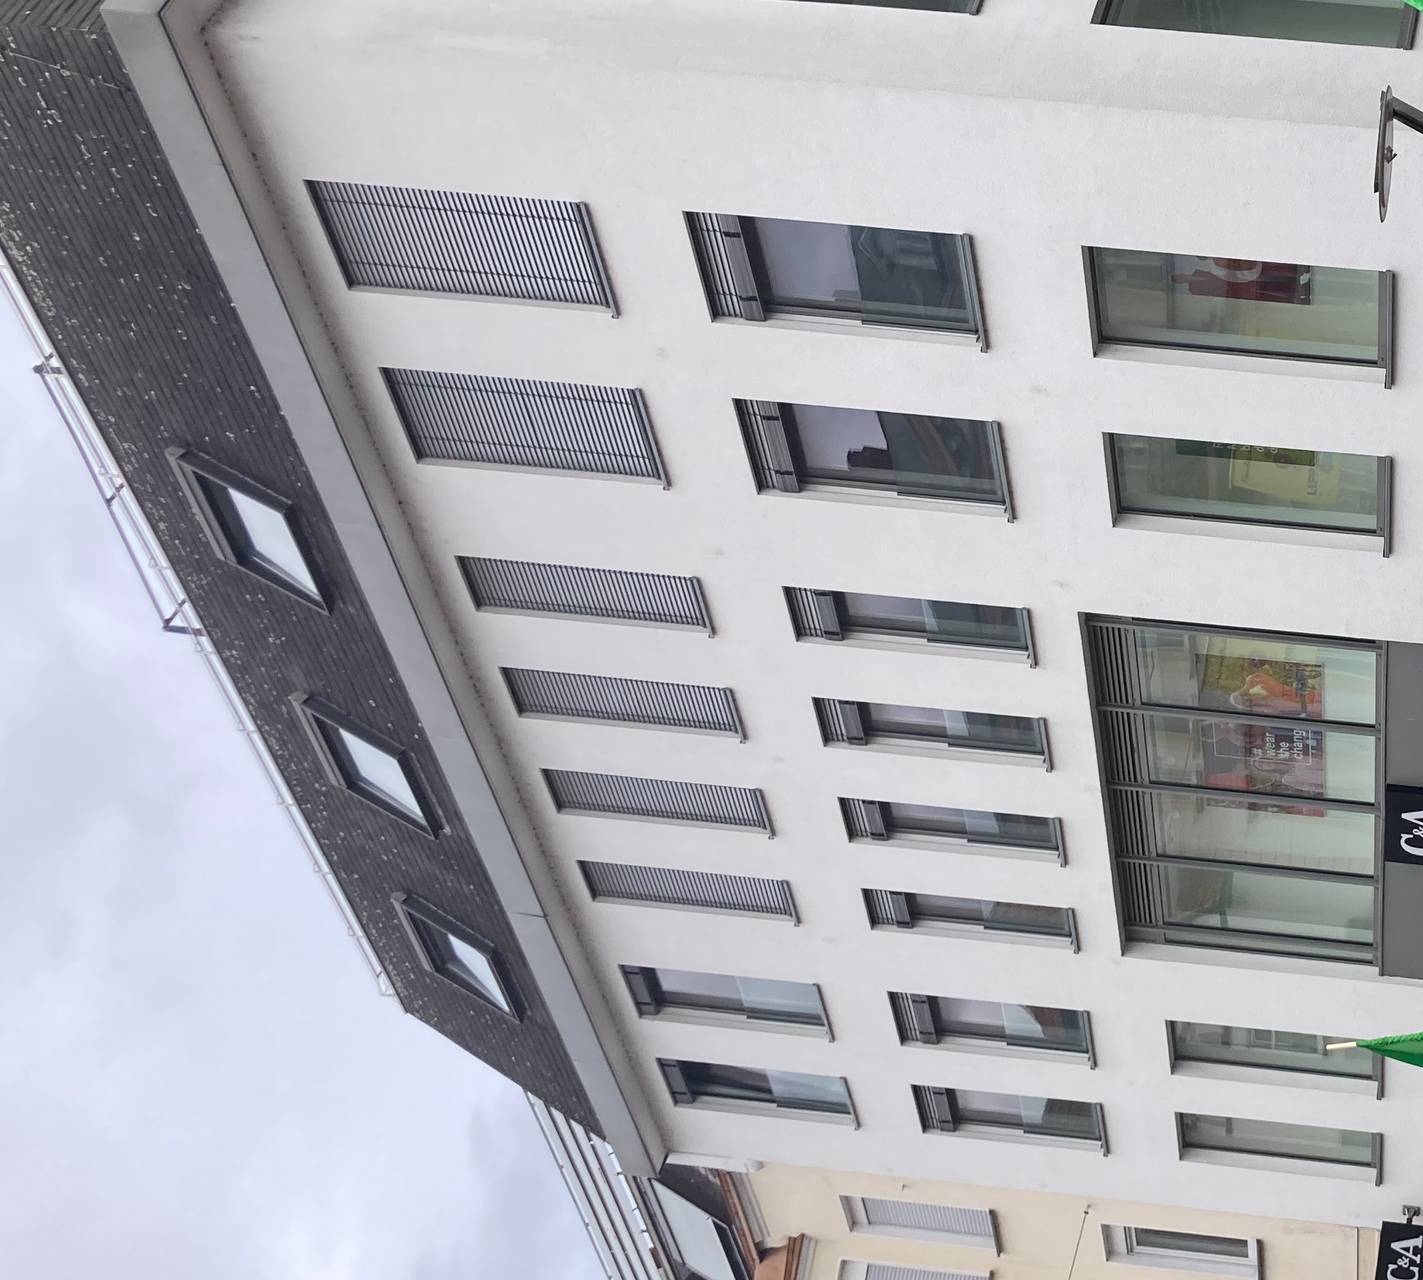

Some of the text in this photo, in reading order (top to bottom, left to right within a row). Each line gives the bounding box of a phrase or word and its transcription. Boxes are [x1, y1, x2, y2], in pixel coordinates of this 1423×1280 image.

[1265, 732, 1275, 755] wear
[1277, 742, 1289, 759] the
[1387, 1235, 1423, 1280] C&A
